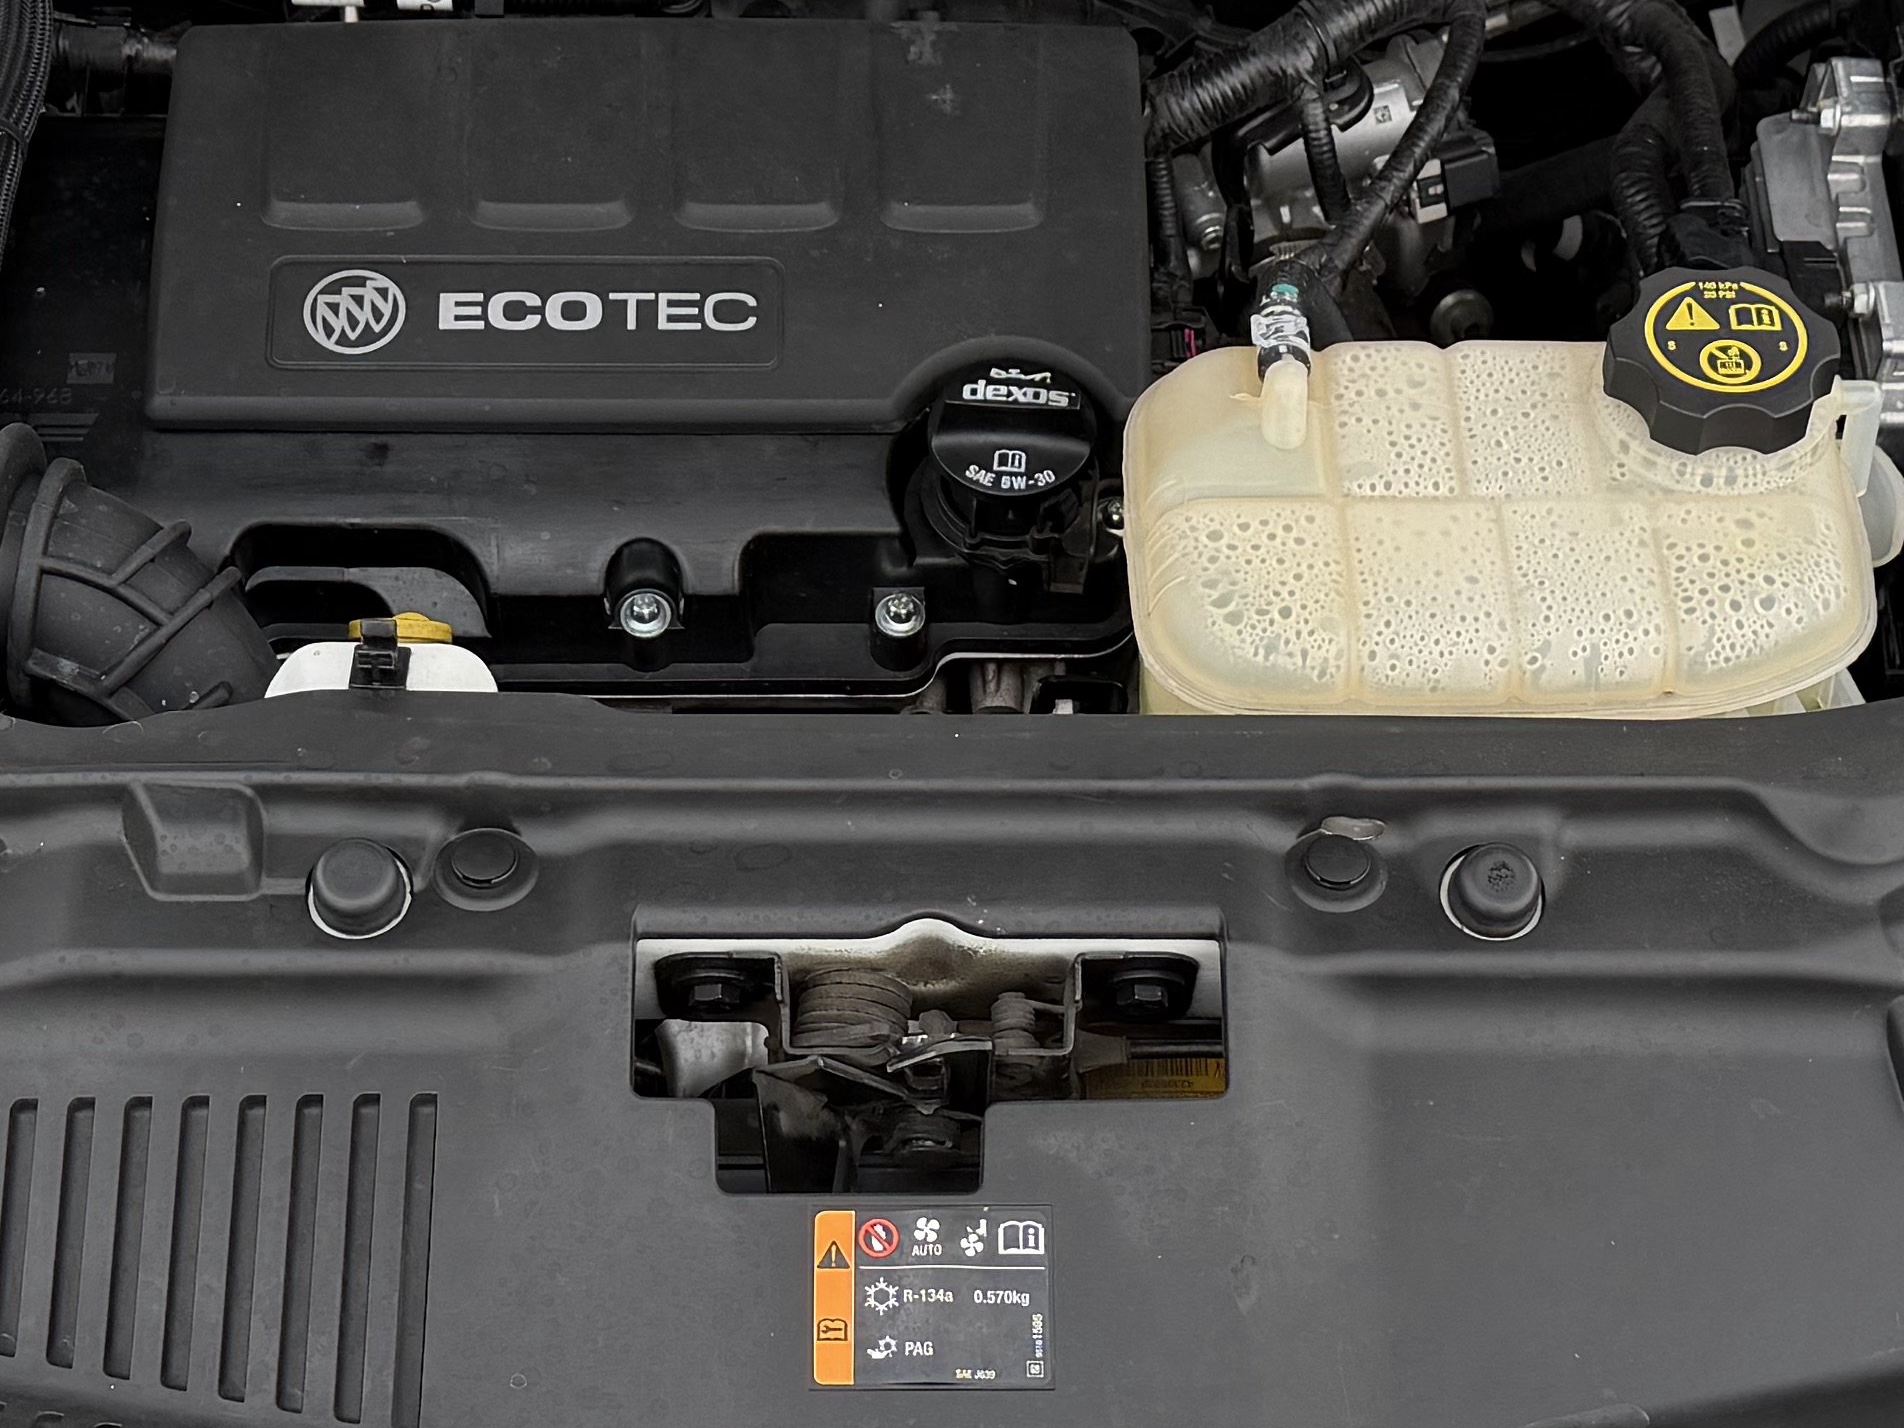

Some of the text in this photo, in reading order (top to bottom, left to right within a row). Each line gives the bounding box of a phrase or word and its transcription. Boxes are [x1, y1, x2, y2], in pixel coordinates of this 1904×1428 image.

[437, 291, 760, 333] ECOTEC
[962, 379, 1070, 407] dexos
[965, 465, 1056, 490] SAE 5W-30
[911, 1243, 942, 1257] AUTO
[902, 1288, 1030, 1308] R-134a 0.570kg
[904, 1341, 934, 1357] PAG
